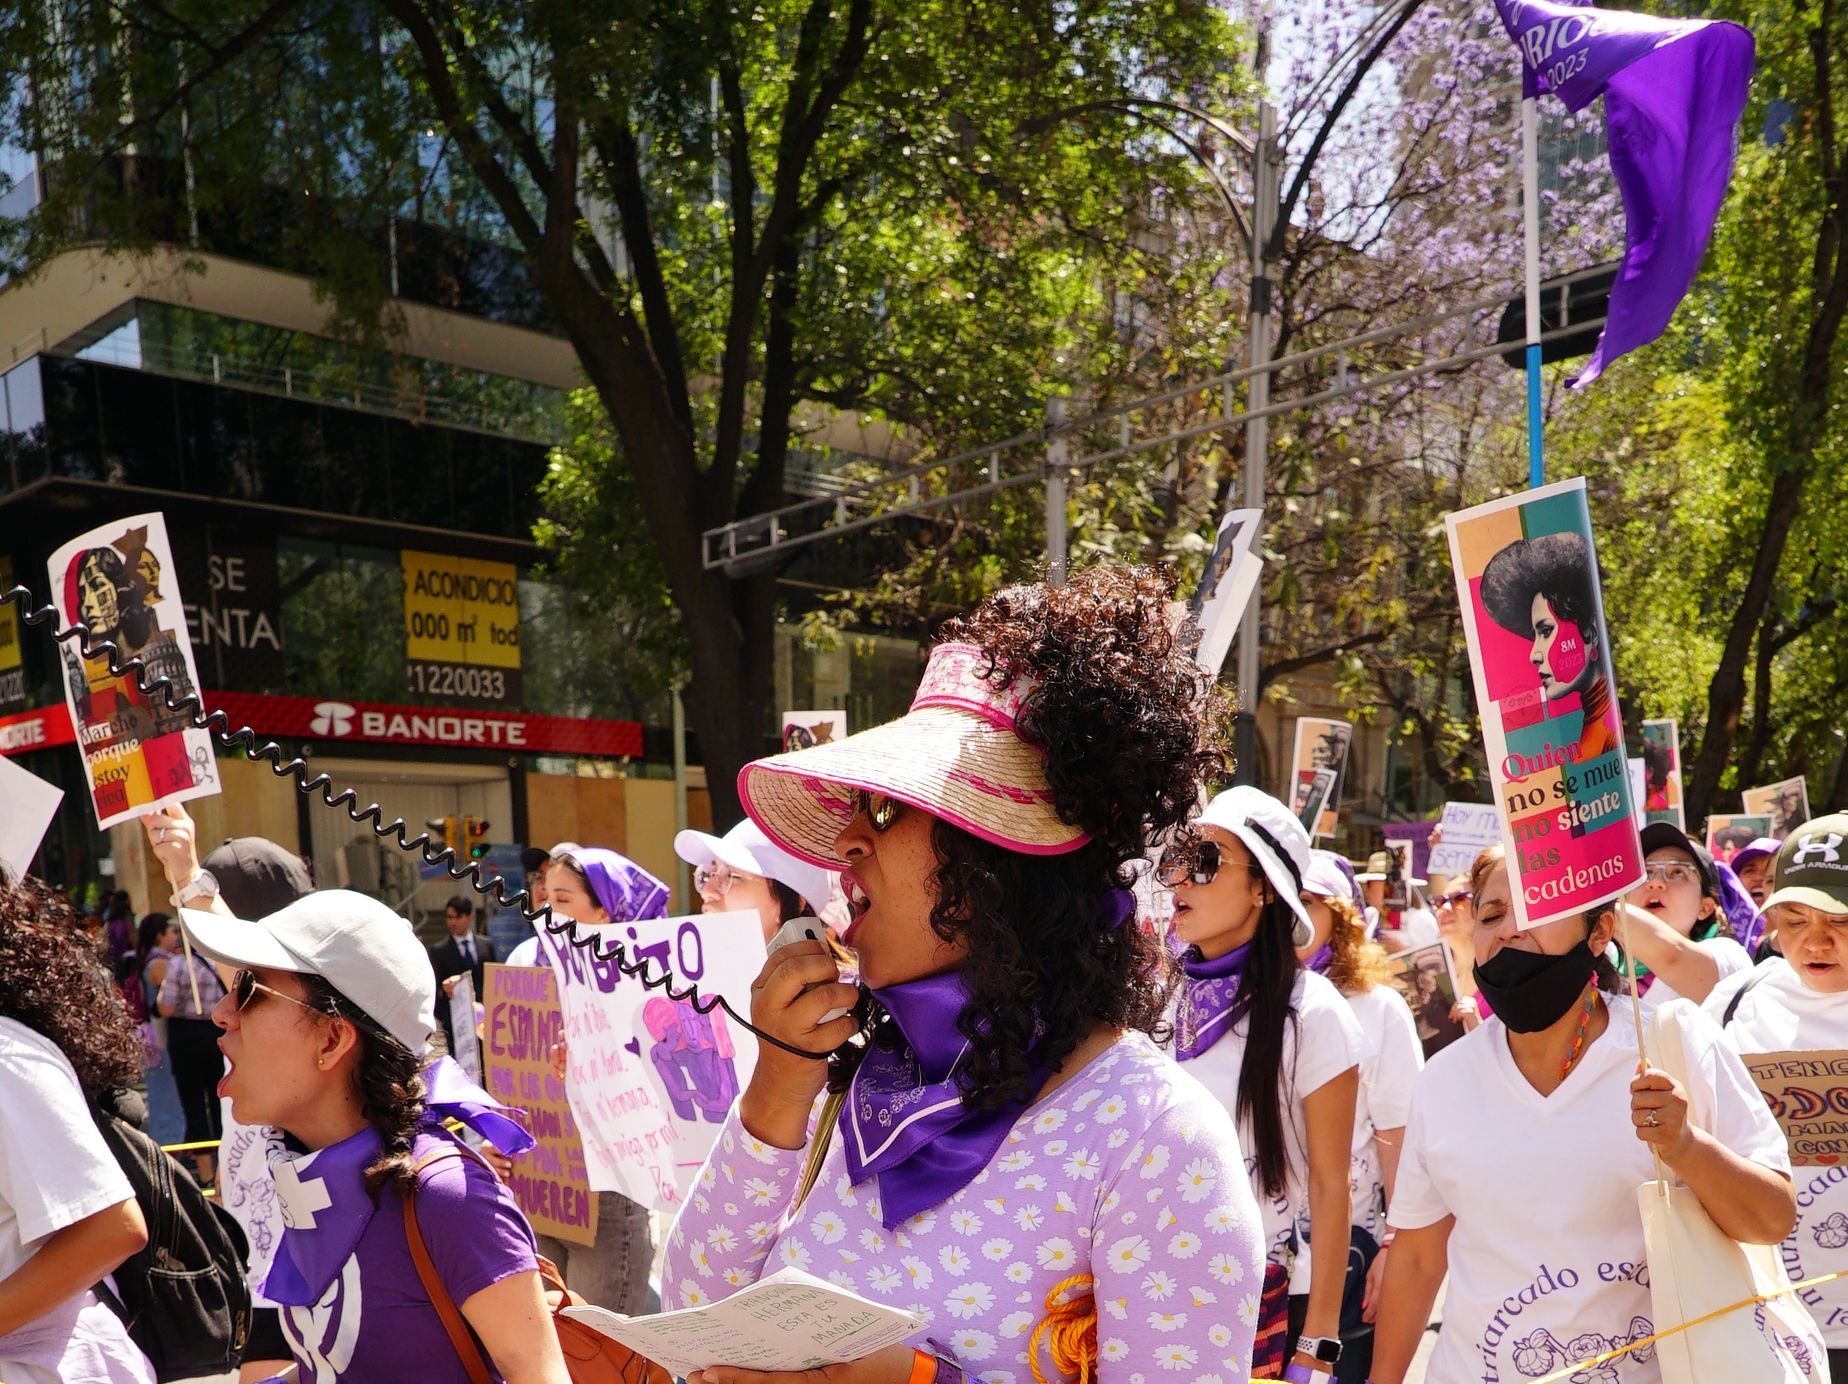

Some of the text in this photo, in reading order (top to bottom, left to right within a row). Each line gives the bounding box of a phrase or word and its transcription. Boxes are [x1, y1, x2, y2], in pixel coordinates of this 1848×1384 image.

[1545, 46, 1590, 91] 2023
[208, 555, 247, 591] SE
[1560, 638, 1577, 652] 8M
[79, 716, 138, 746] Marcho
[362, 711, 527, 745] BANORTE
[86, 738, 140, 765] porque
[1502, 742, 1584, 784] Quien
[1507, 787, 1545, 814] no
[1552, 776, 1579, 799] se
[1514, 791, 1621, 844] no siente
[1516, 847, 1561, 875] las
[1524, 855, 1624, 905] cadenas
[509, 1175, 590, 1230] MUEREN
[751, 1287, 826, 1322] HERMANA
[776, 1298, 839, 1333] ESTA ES
[809, 1313, 839, 1329] TU
[811, 1311, 877, 1345] MANADA
